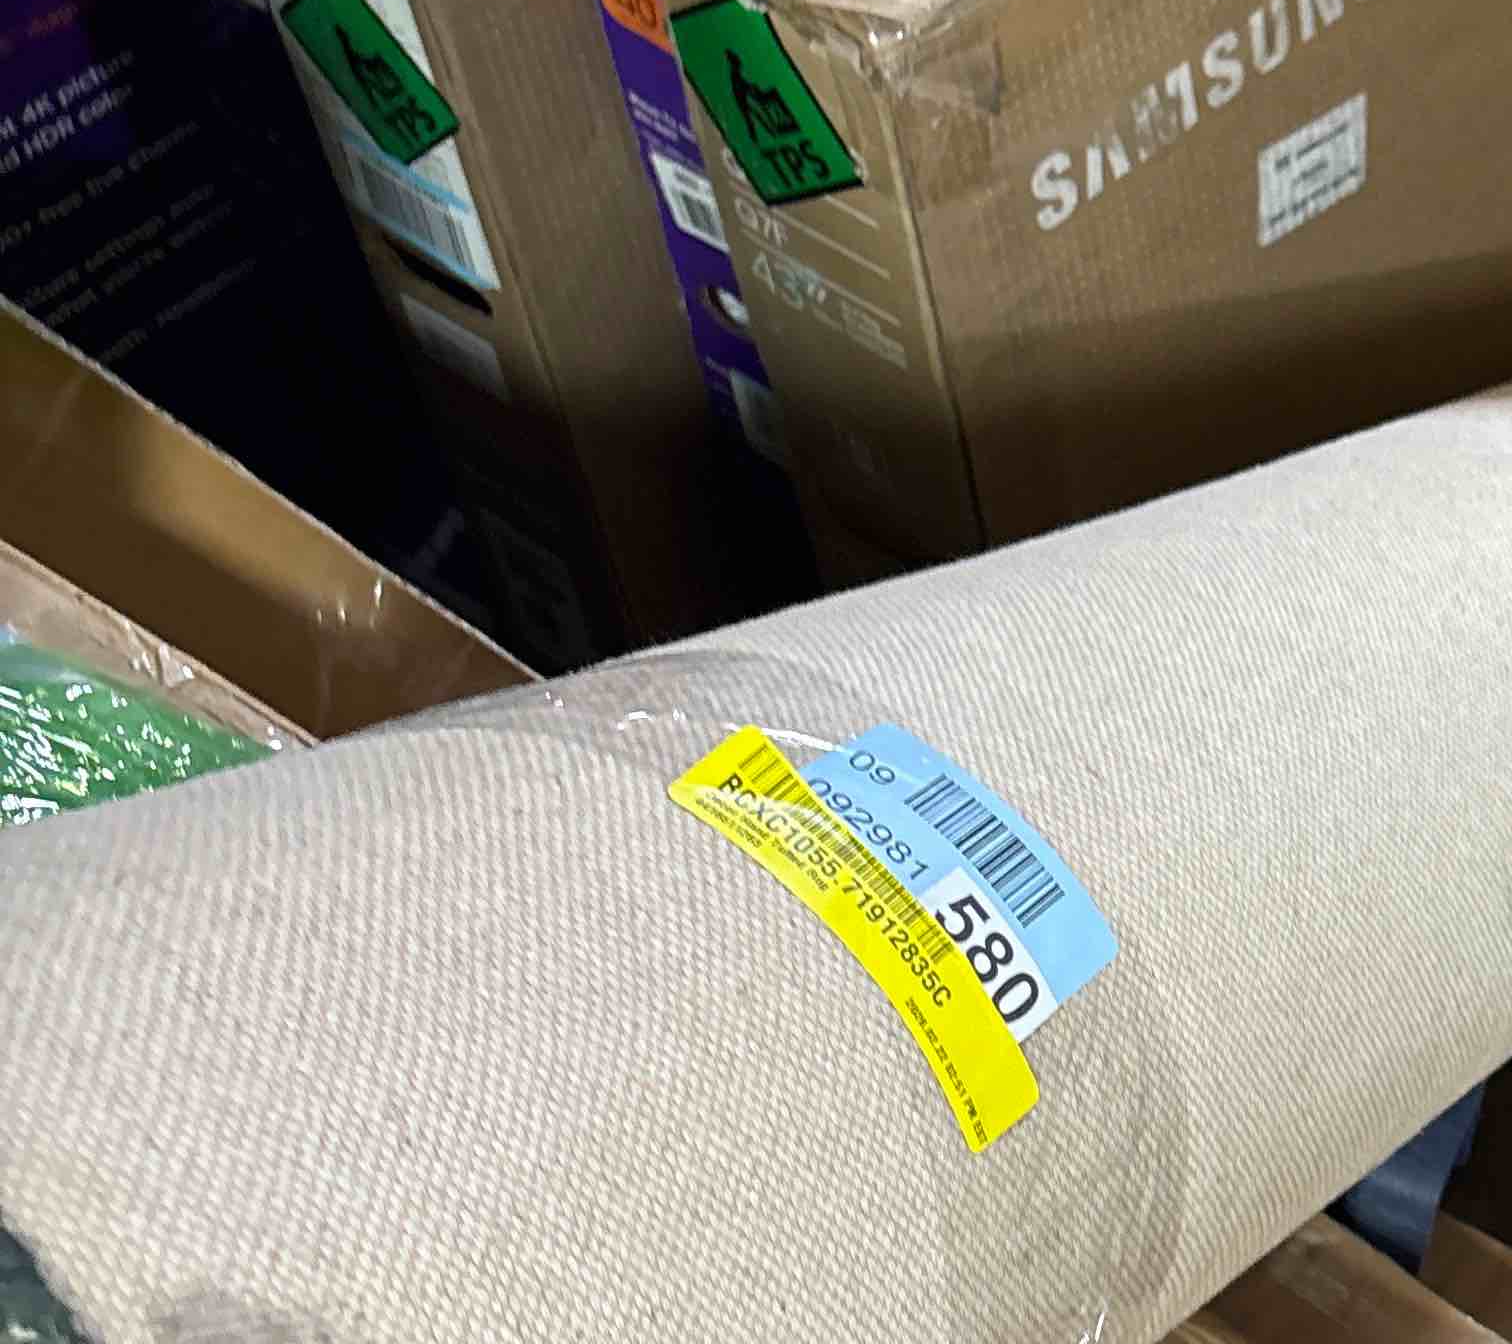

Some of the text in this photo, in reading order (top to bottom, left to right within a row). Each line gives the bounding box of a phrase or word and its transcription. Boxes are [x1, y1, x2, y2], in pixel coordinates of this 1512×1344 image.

[759, 138, 832, 190] TPS
[848, 746, 898, 788] 09
[805, 776, 930, 883] 092981
[934, 892, 1041, 1025] 580
